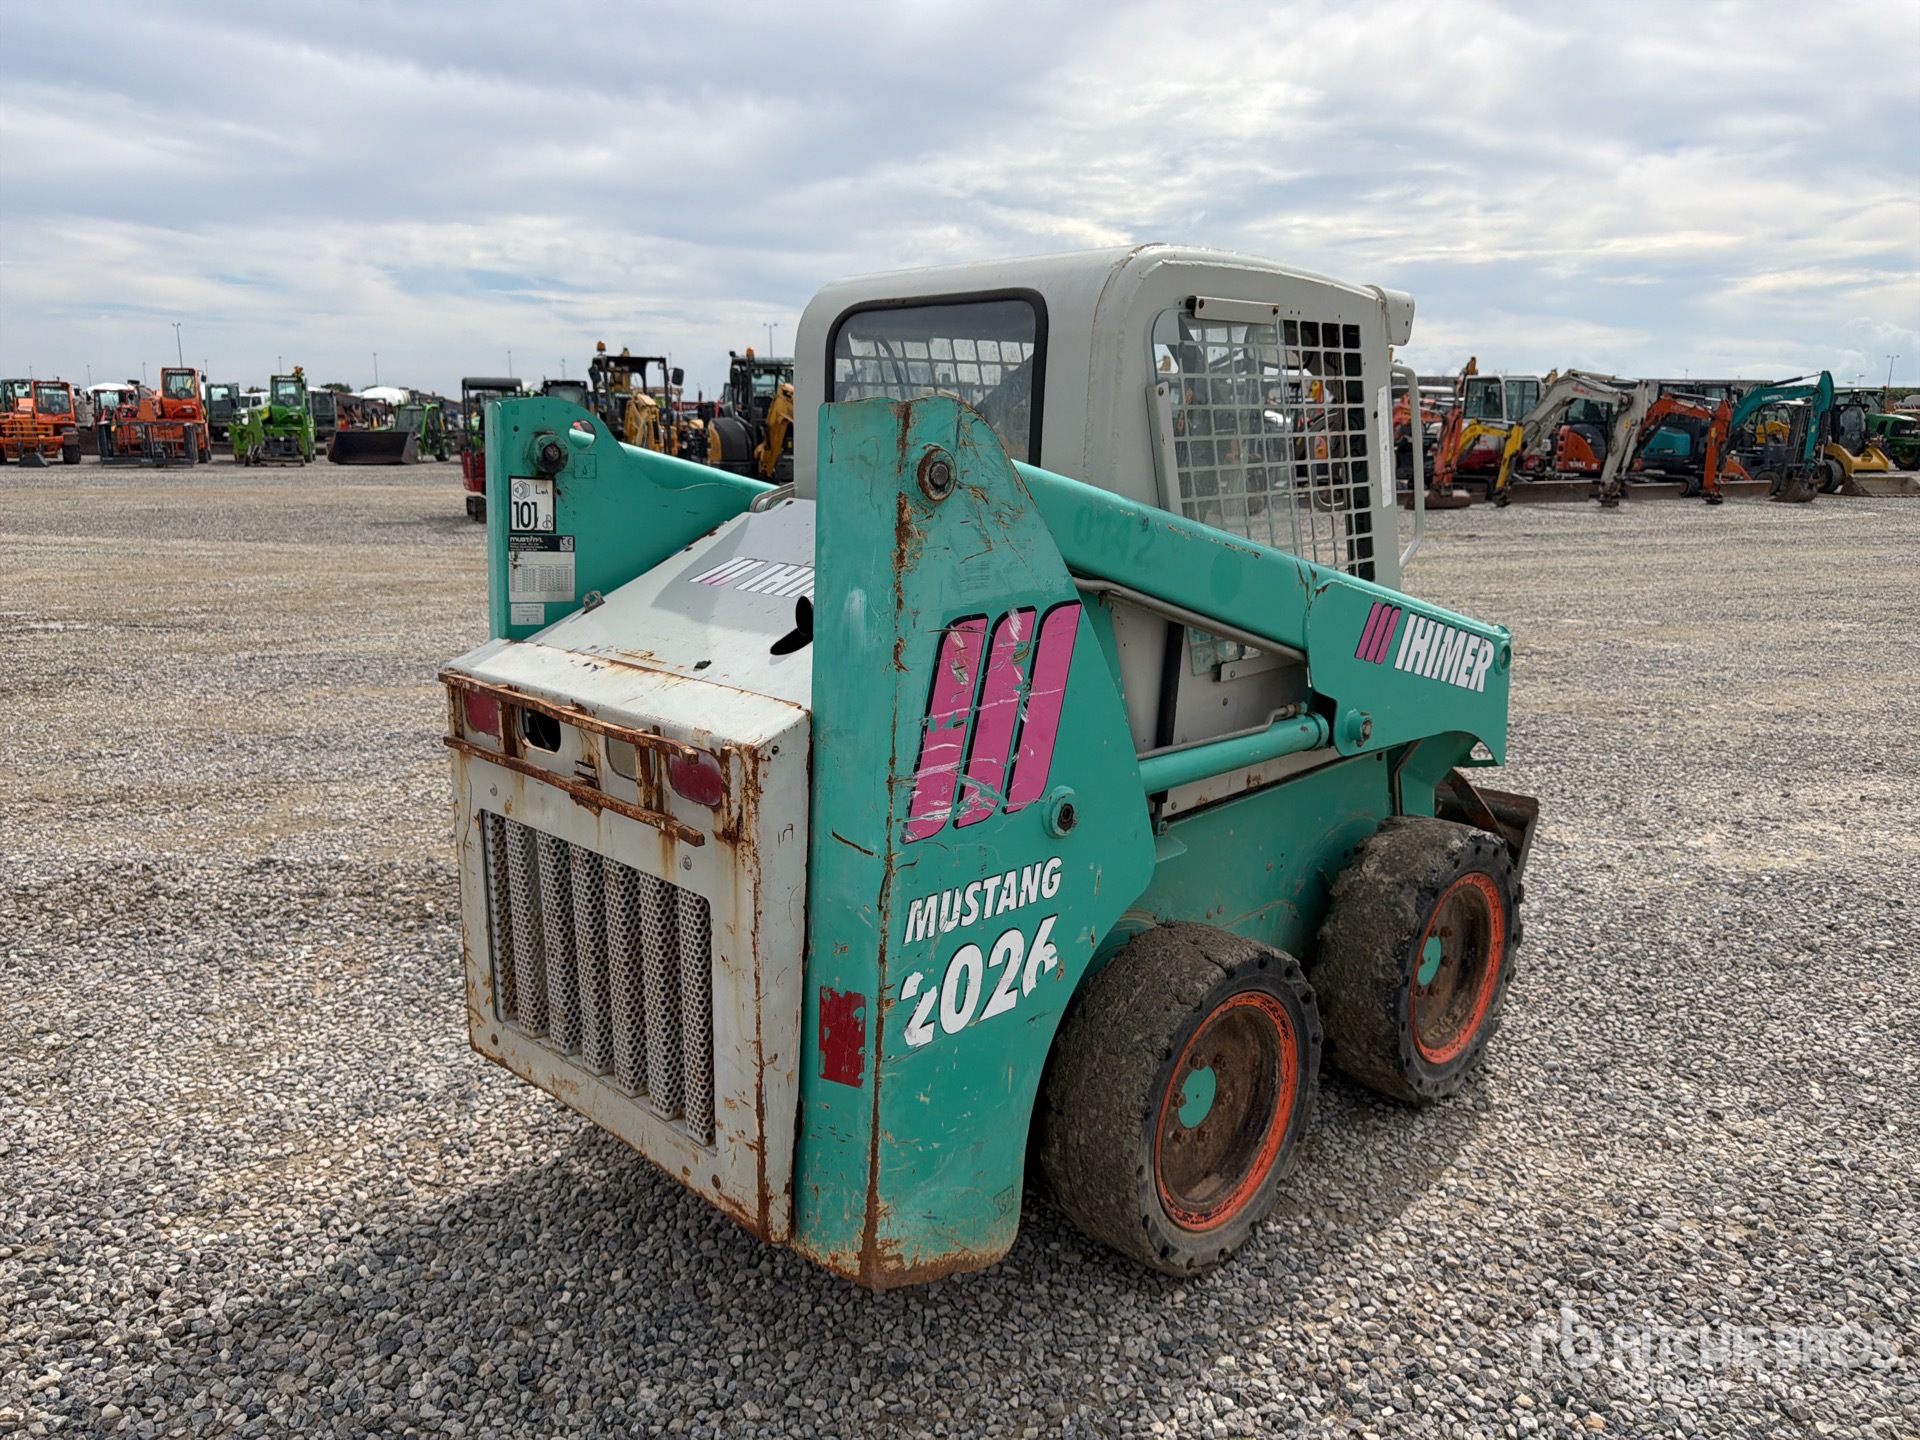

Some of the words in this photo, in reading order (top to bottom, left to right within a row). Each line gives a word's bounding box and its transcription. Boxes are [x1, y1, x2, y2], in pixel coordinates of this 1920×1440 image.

[513, 501, 537, 528] 101
[542, 514, 553, 529] dB
[1394, 611, 1495, 694] IHIMER
[903, 856, 1063, 946] MUSTANG
[900, 914, 1058, 1048] 2026
